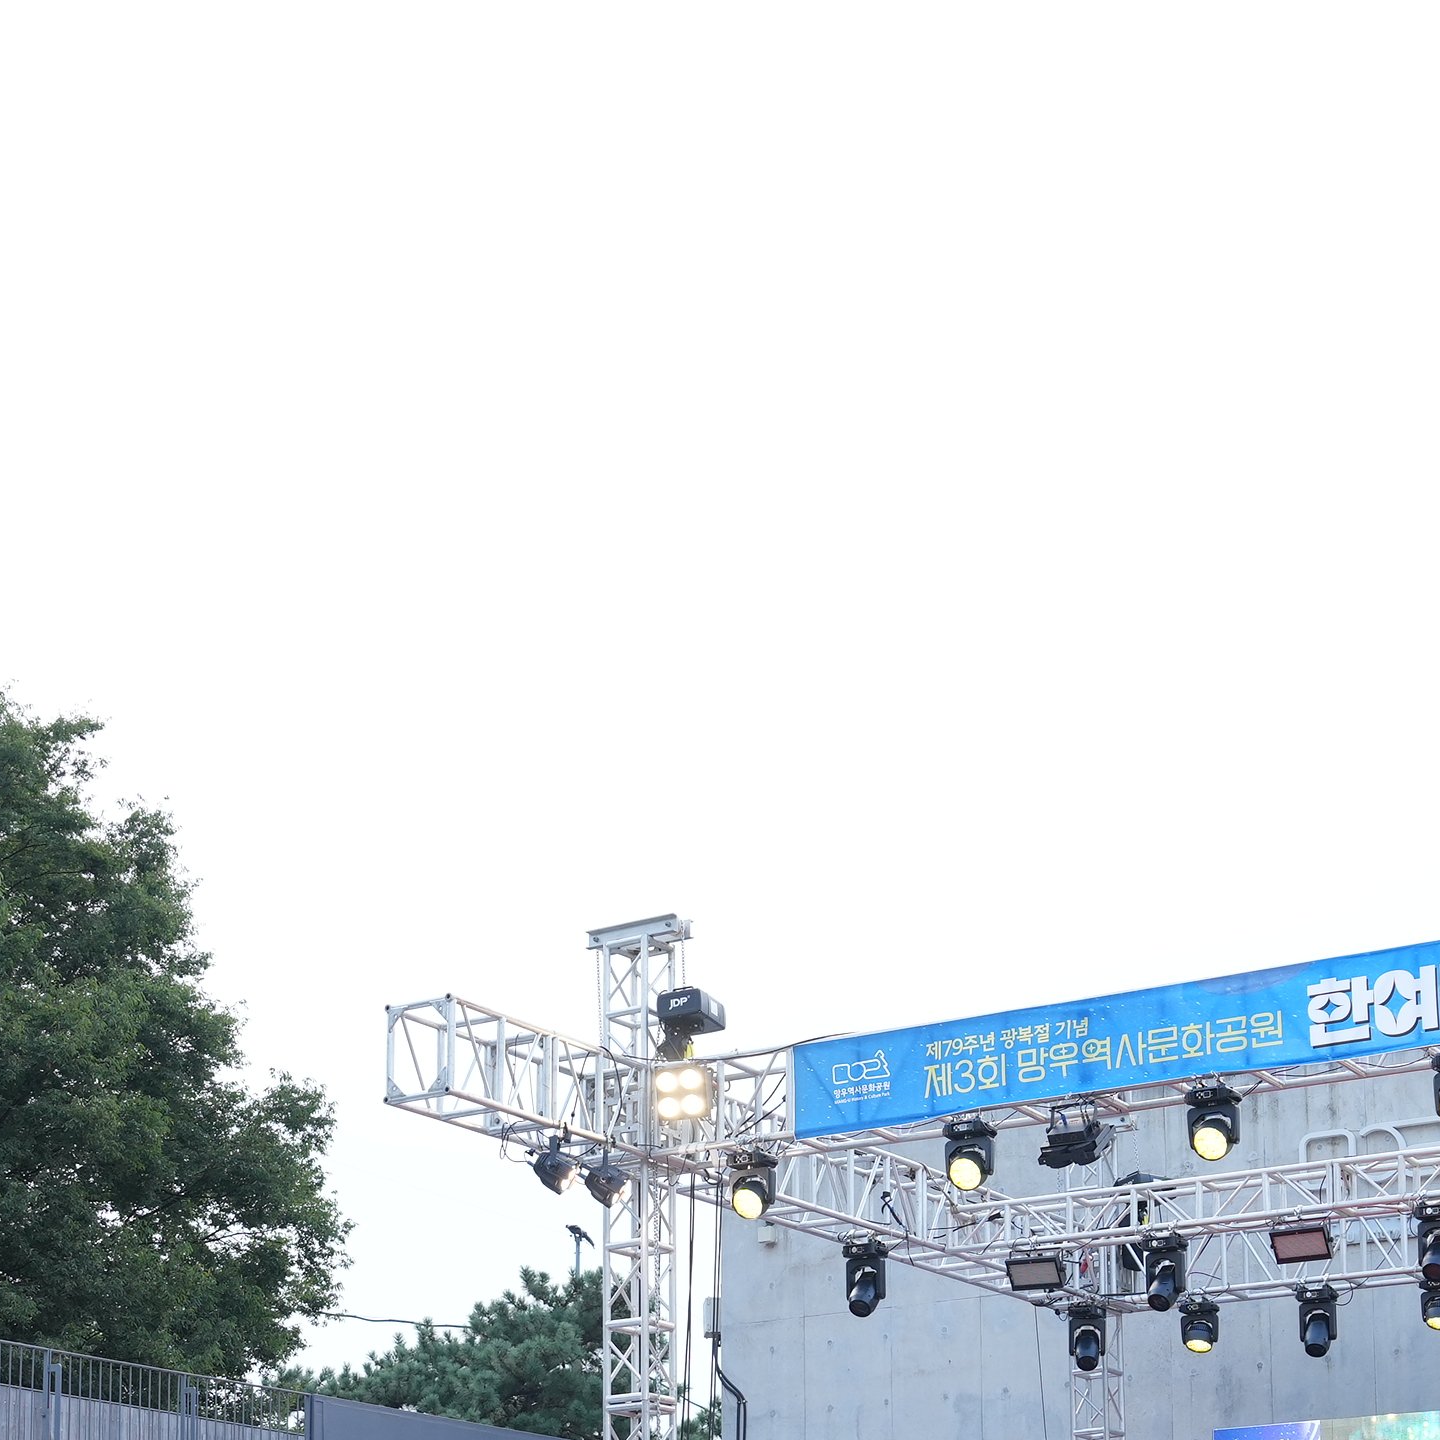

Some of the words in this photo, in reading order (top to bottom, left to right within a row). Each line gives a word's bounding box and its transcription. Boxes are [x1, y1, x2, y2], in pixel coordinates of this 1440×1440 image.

[923, 1053, 1008, 1099] 제3회
[1016, 1009, 1284, 1083] 망우역사문화공원
[925, 1030, 998, 1060] 제79주년
[998, 1021, 1051, 1049] 광복절
[1054, 1016, 1090, 1040] 기념
[833, 1081, 891, 1099] 망우역사문화공원
